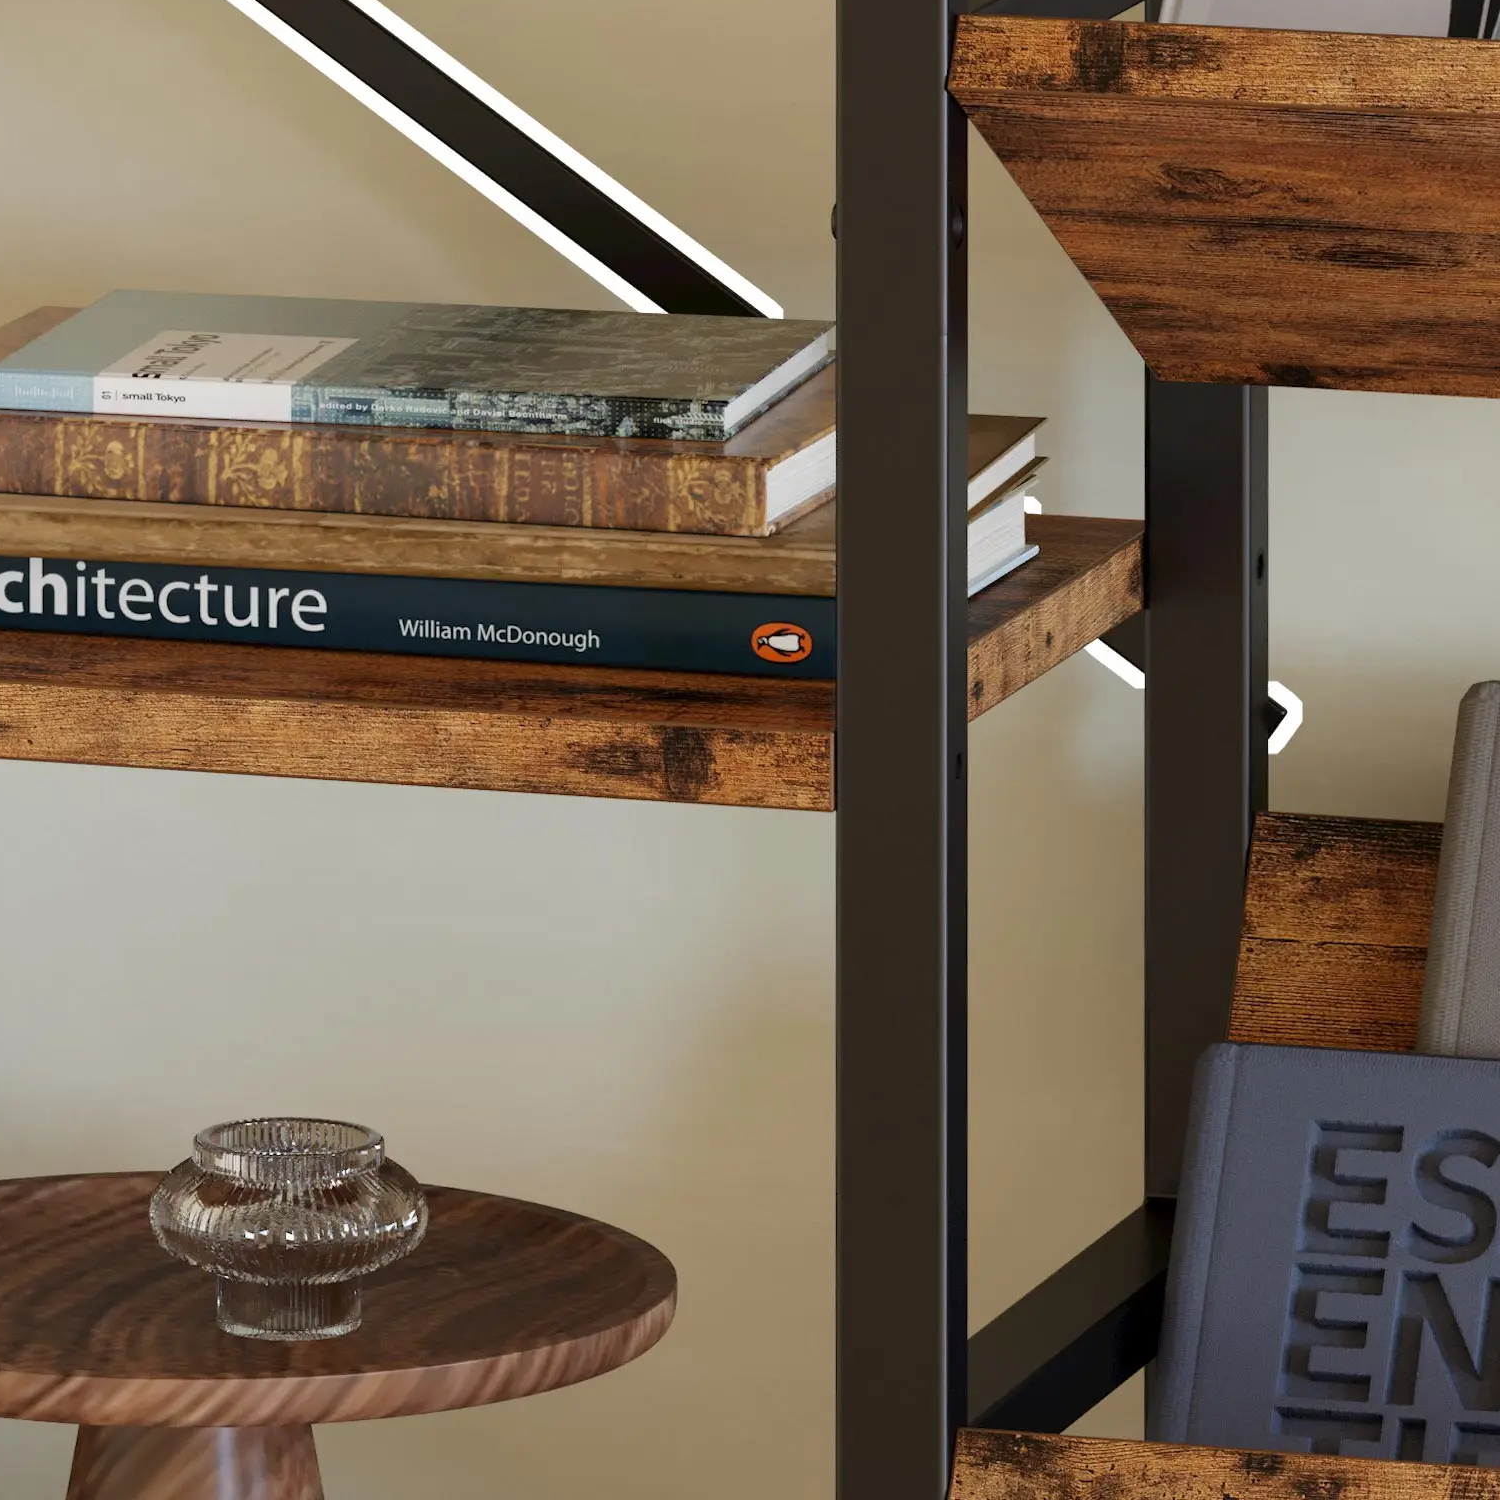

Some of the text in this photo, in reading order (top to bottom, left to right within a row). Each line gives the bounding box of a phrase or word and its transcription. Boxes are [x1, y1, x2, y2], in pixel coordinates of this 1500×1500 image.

[122, 391, 153, 401] small
[155, 392, 186, 404] Tokyo
[320, 401, 353, 411] edited
[355, 403, 368, 413] by
[398, 618, 601, 653] William McDonough
